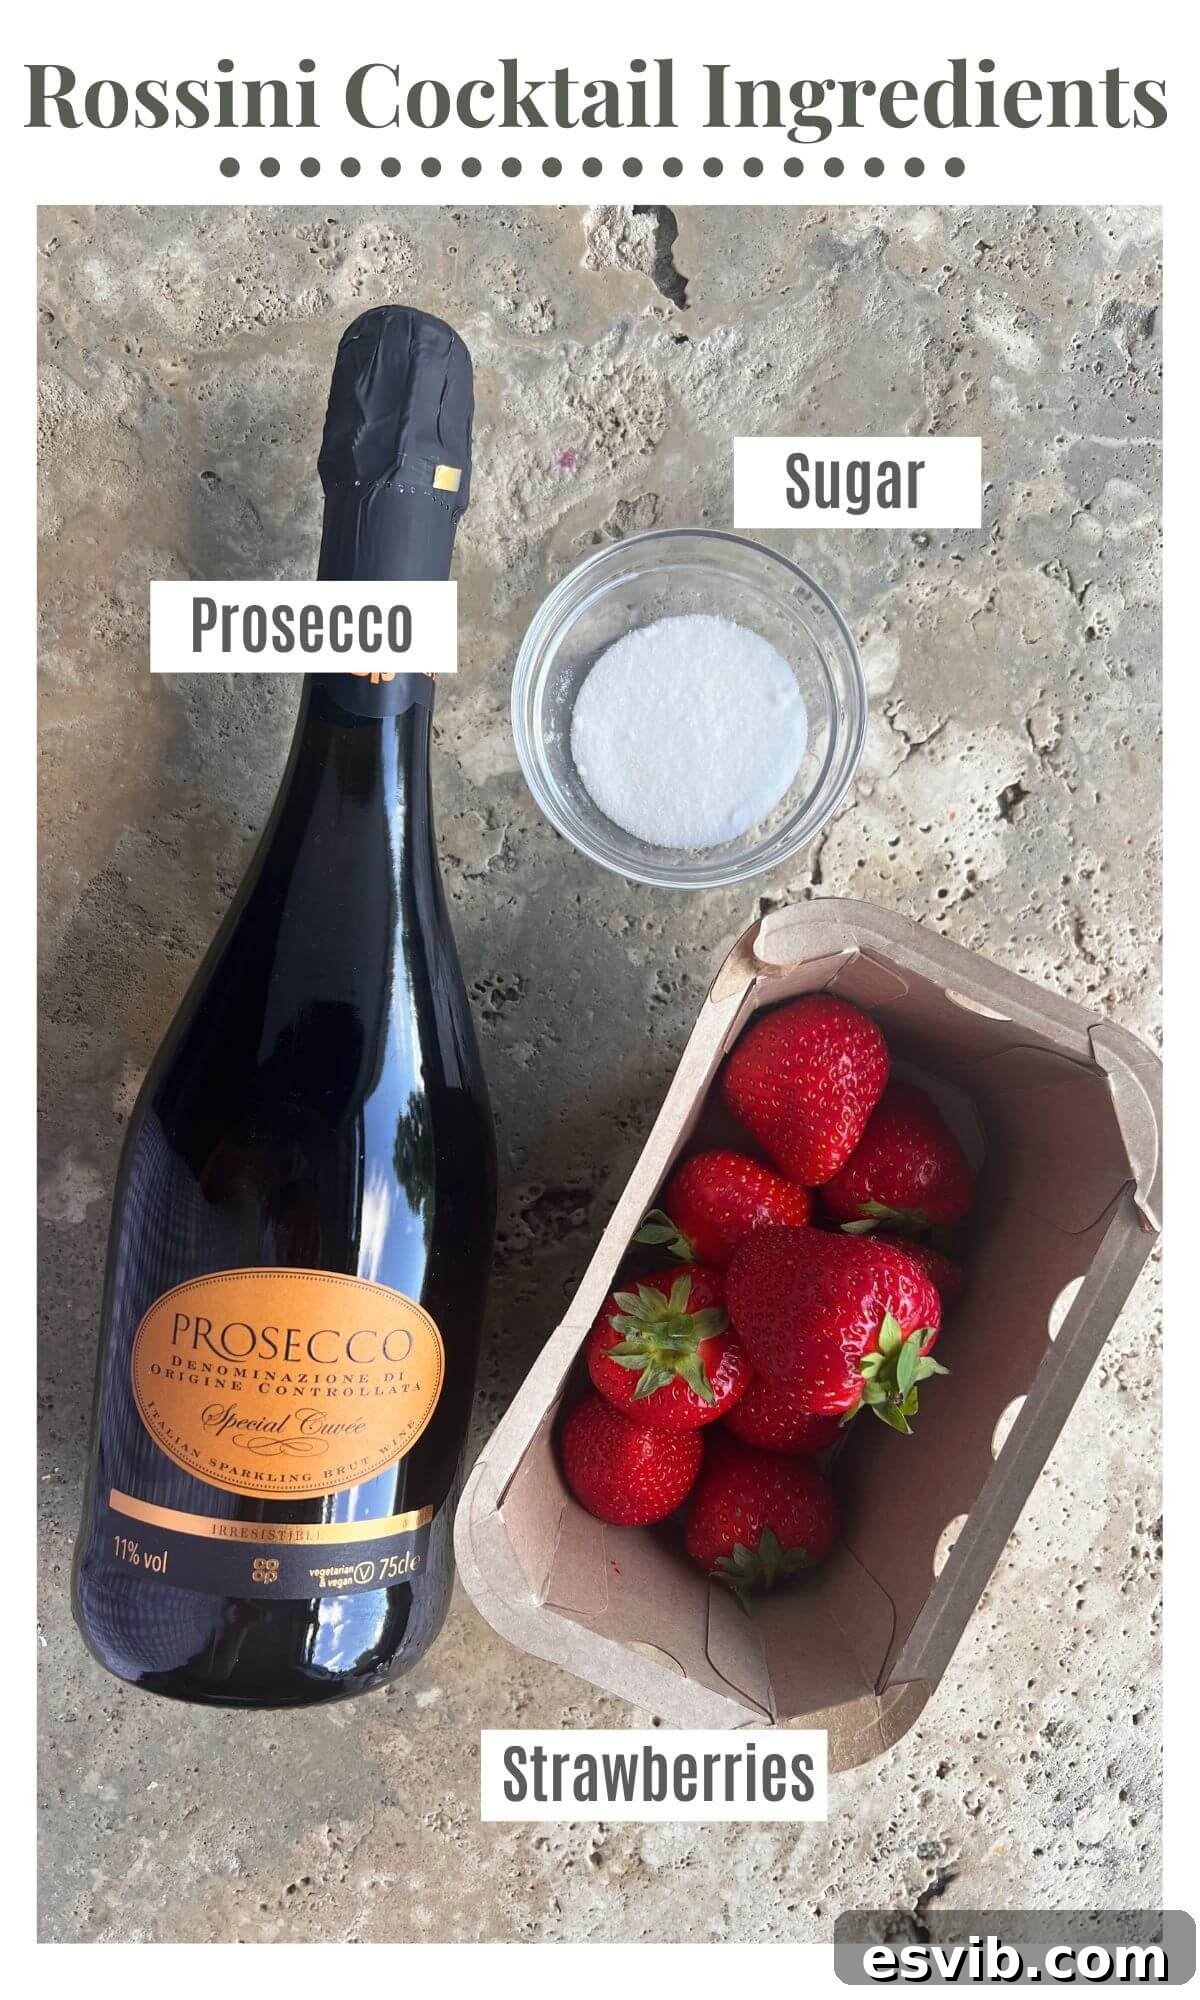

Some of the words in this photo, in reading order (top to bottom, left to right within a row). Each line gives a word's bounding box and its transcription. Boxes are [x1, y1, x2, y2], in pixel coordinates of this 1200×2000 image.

[171, 1313, 414, 1364] PROSECCO
[150, 1364, 242, 1392] ORIGINE
[258, 1380, 422, 1397] CONTROLLATA
[171, 1355, 369, 1384] DENOMINAZIONE
[384, 1372, 404, 1382] DI
[200, 1403, 291, 1436] Special
[294, 1407, 367, 1435] Cuvée
[147, 1401, 201, 1458] ITALIAN
[208, 1459, 312, 1483] SPARKLING
[323, 1457, 370, 1479] BRUT
[379, 1419, 417, 1454] WINE
[114, 1535, 140, 1566] 11%
[144, 1550, 168, 1574] vol
[309, 1564, 354, 1577] vegetarian
[328, 1576, 353, 1588] vegan
